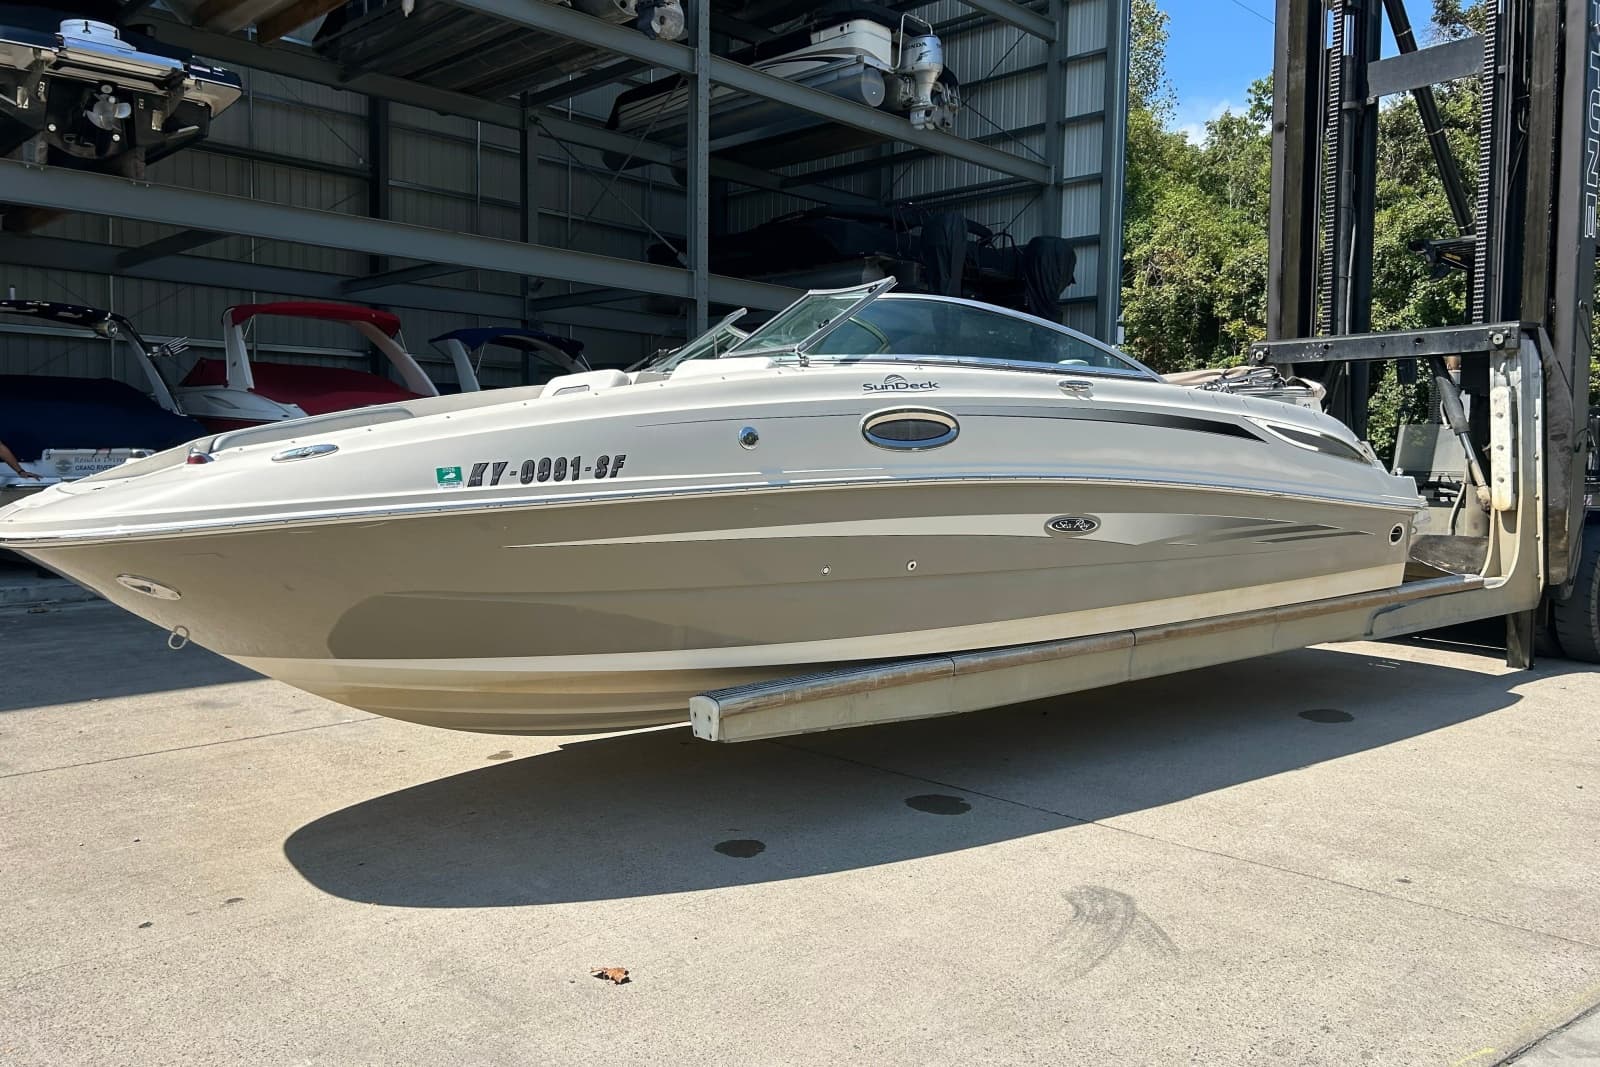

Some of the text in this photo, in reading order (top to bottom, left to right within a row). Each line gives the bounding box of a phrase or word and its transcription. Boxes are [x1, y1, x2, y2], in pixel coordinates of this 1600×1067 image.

[862, 381, 941, 391] SunDeck
[75, 464, 95, 472] GRAND
[467, 454, 627, 488] KY-0991-SF
[1055, 519, 1090, 531] Sea Ray
